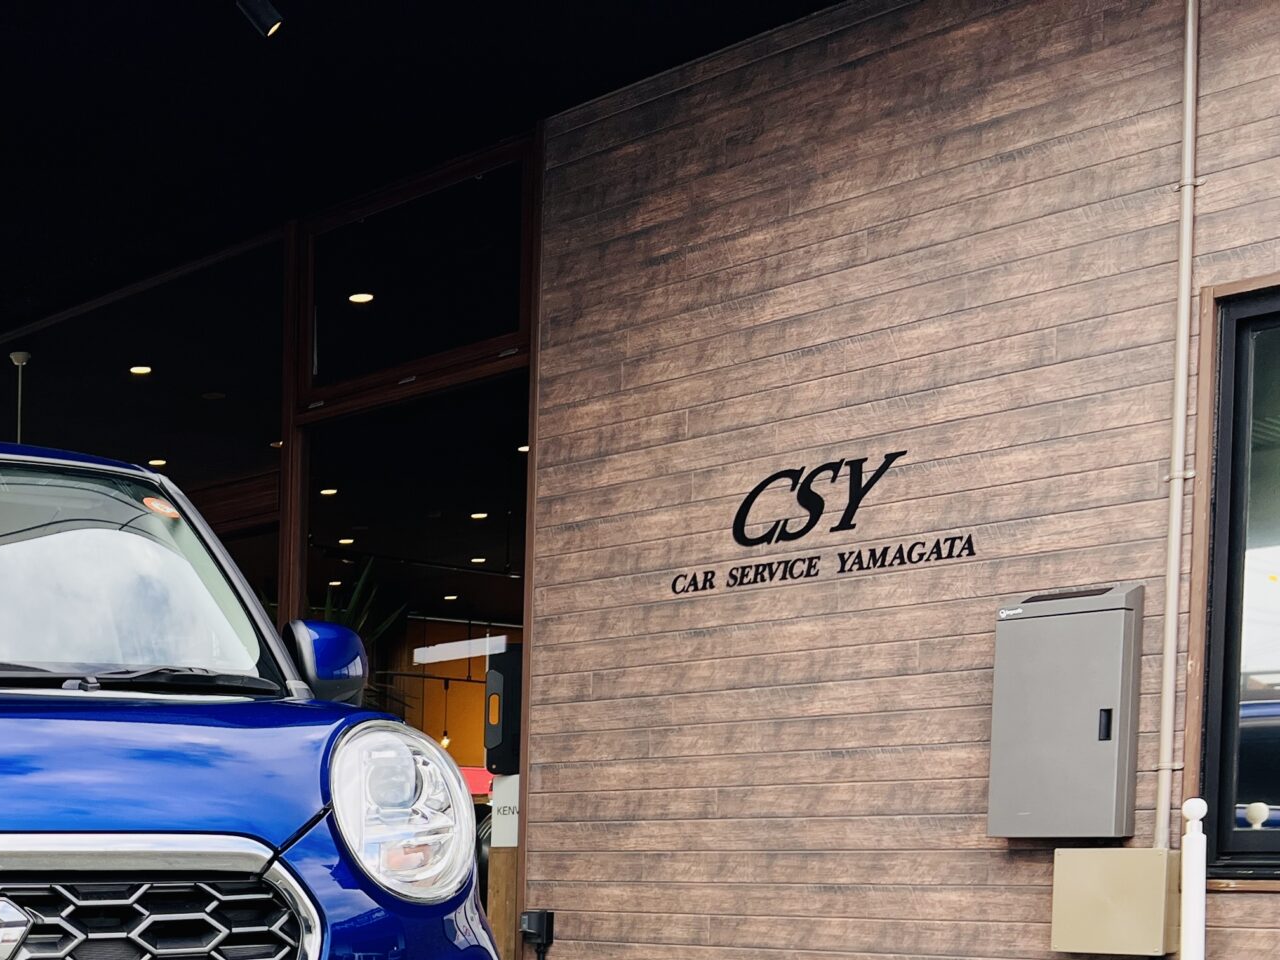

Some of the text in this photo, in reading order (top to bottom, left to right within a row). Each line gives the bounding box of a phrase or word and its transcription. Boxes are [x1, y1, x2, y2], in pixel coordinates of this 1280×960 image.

[732, 450, 908, 547] CSY
[671, 534, 977, 595] CAR SERVICE YAMAGATA
